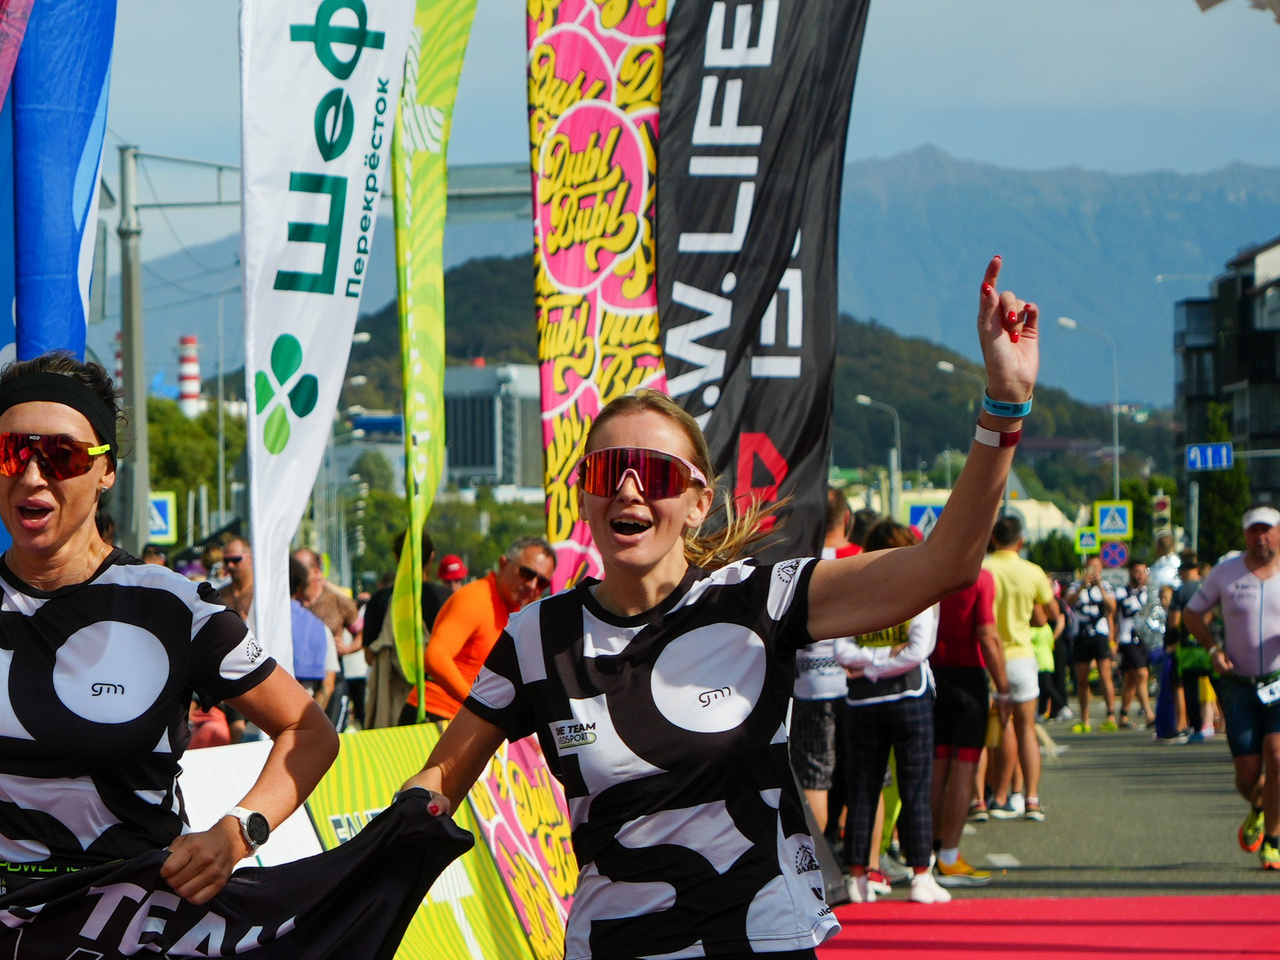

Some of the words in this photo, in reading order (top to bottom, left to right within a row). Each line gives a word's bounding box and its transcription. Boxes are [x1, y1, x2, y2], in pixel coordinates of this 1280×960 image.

[273, 0, 386, 295] Шеф
[345, 76, 390, 298] Перекрёсток
[539, 125, 622, 204] Dubl
[546, 164, 638, 272] Bubl
[567, 722, 596, 734] TEAM
